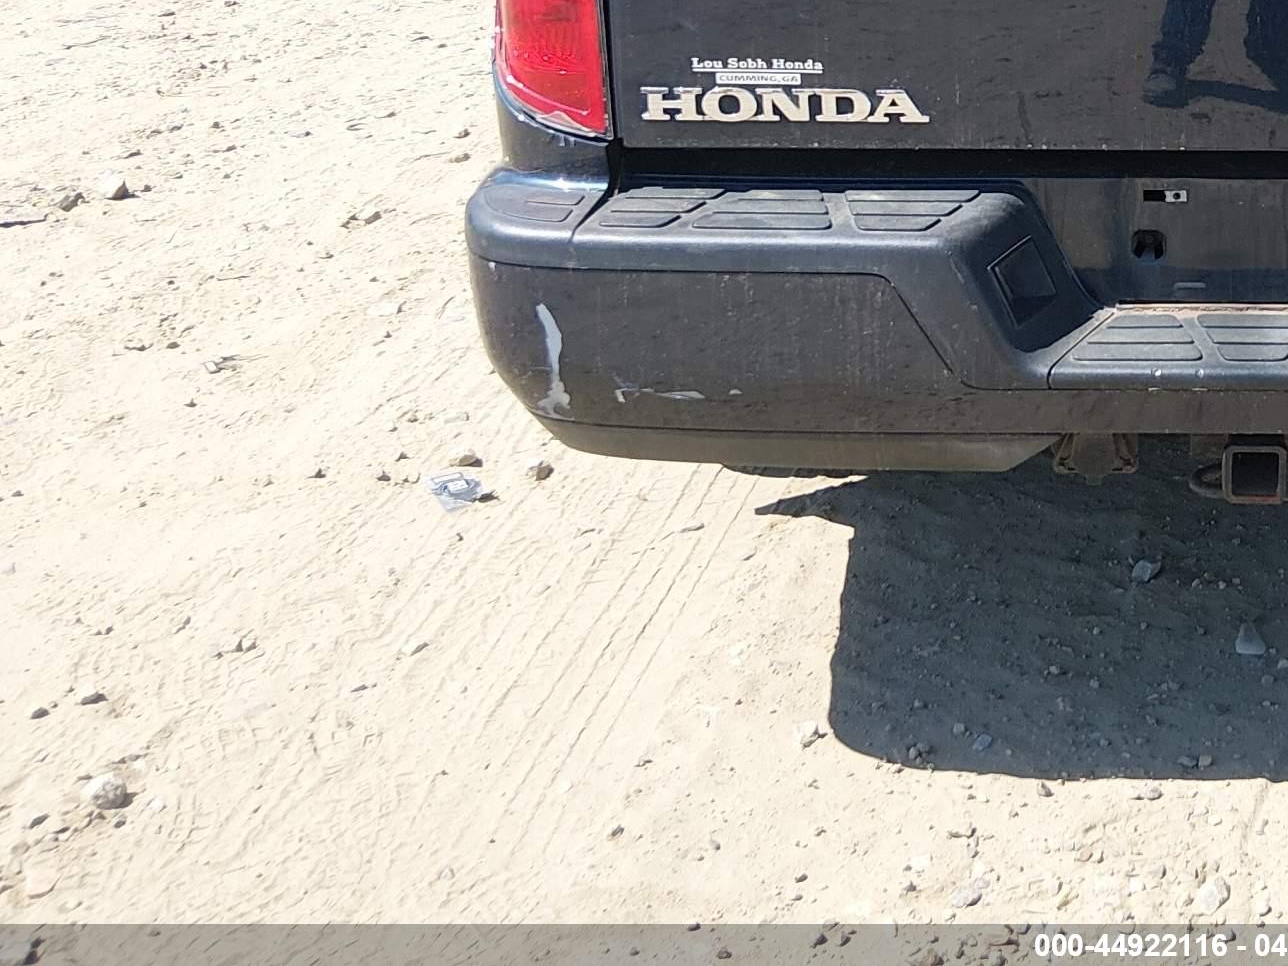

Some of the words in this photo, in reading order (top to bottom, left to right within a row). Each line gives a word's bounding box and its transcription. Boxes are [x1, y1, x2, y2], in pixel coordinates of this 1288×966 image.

[691, 57, 723, 69] Lou
[727, 57, 768, 69] Sobh
[772, 59, 824, 70] Honda
[640, 86, 930, 123] HONDA
